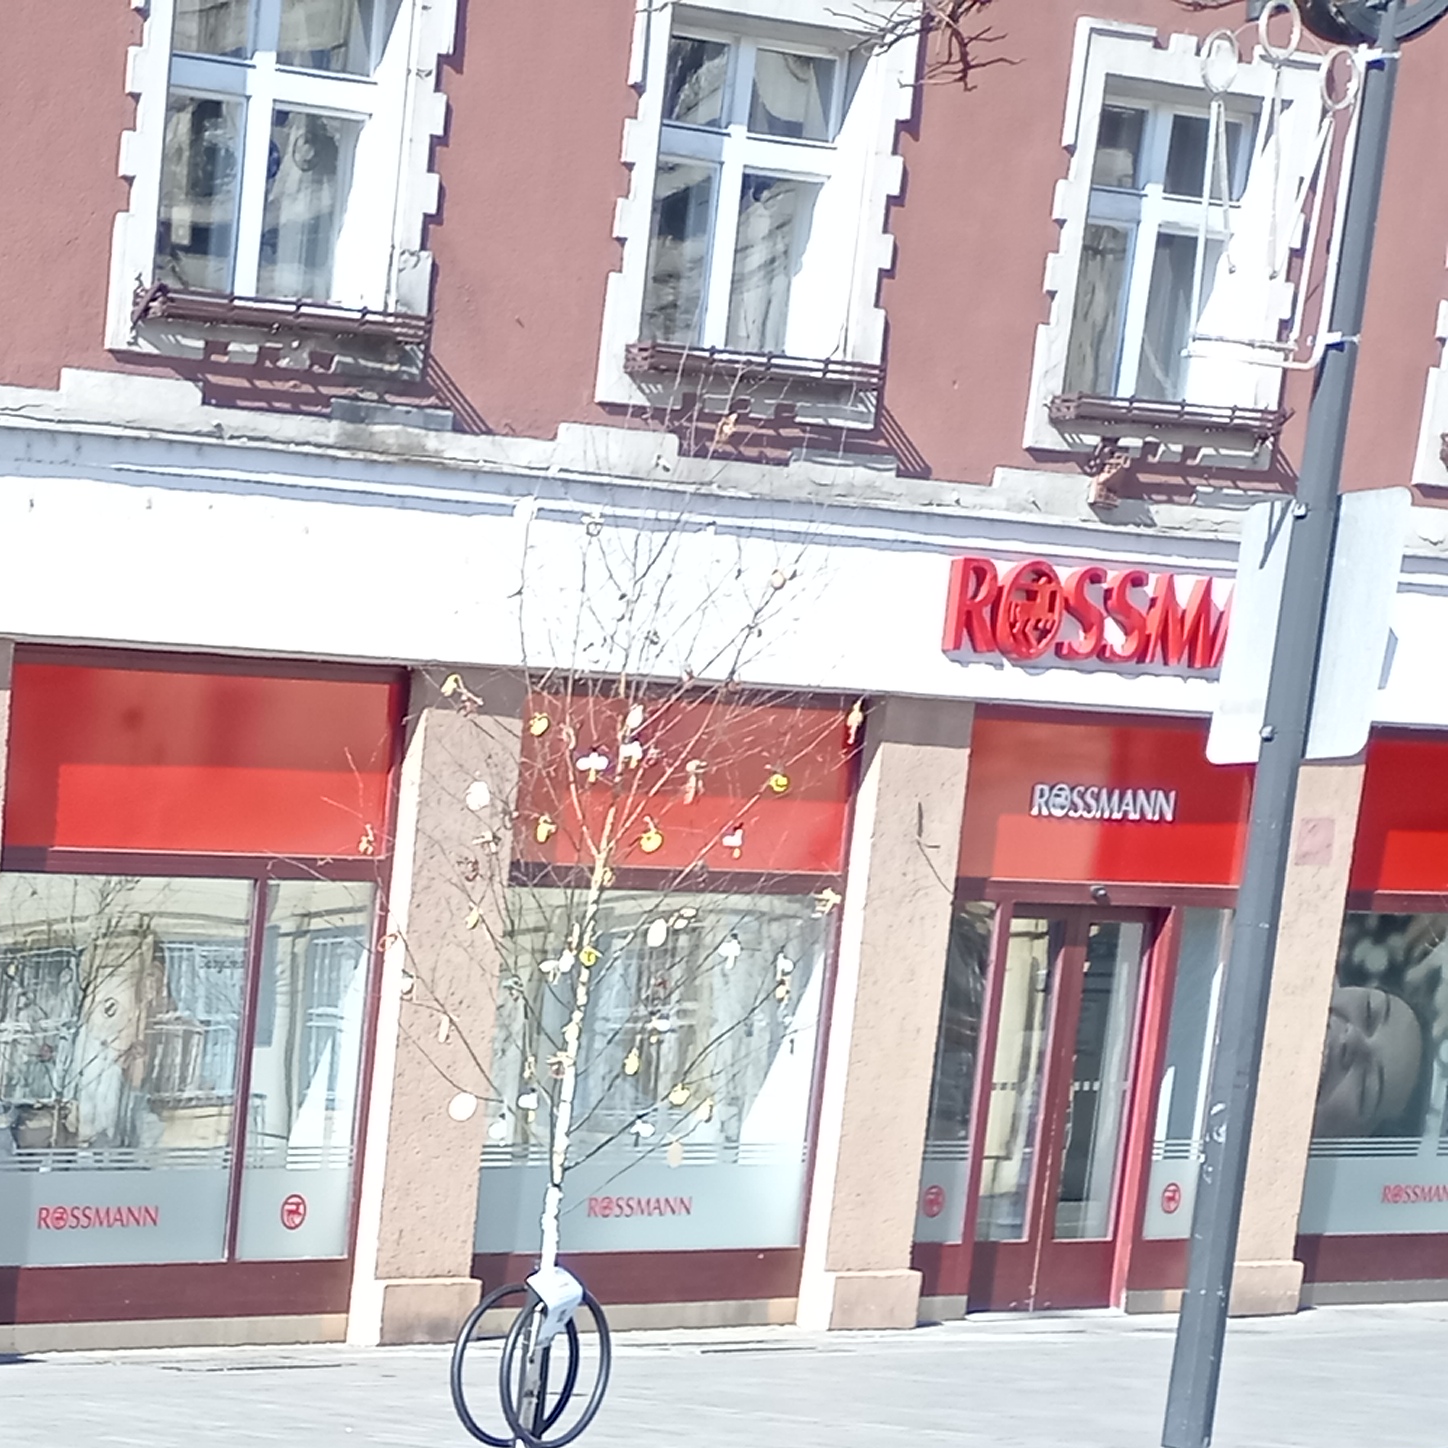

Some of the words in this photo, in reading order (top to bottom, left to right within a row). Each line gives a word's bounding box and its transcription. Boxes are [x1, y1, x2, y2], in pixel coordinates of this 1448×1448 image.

[943, 555, 1237, 670] ROSSM
[1030, 783, 1177, 823] ROSSMANN
[35, 1204, 160, 1230] ROSSMANN
[586, 1195, 693, 1220] ROSSMANN
